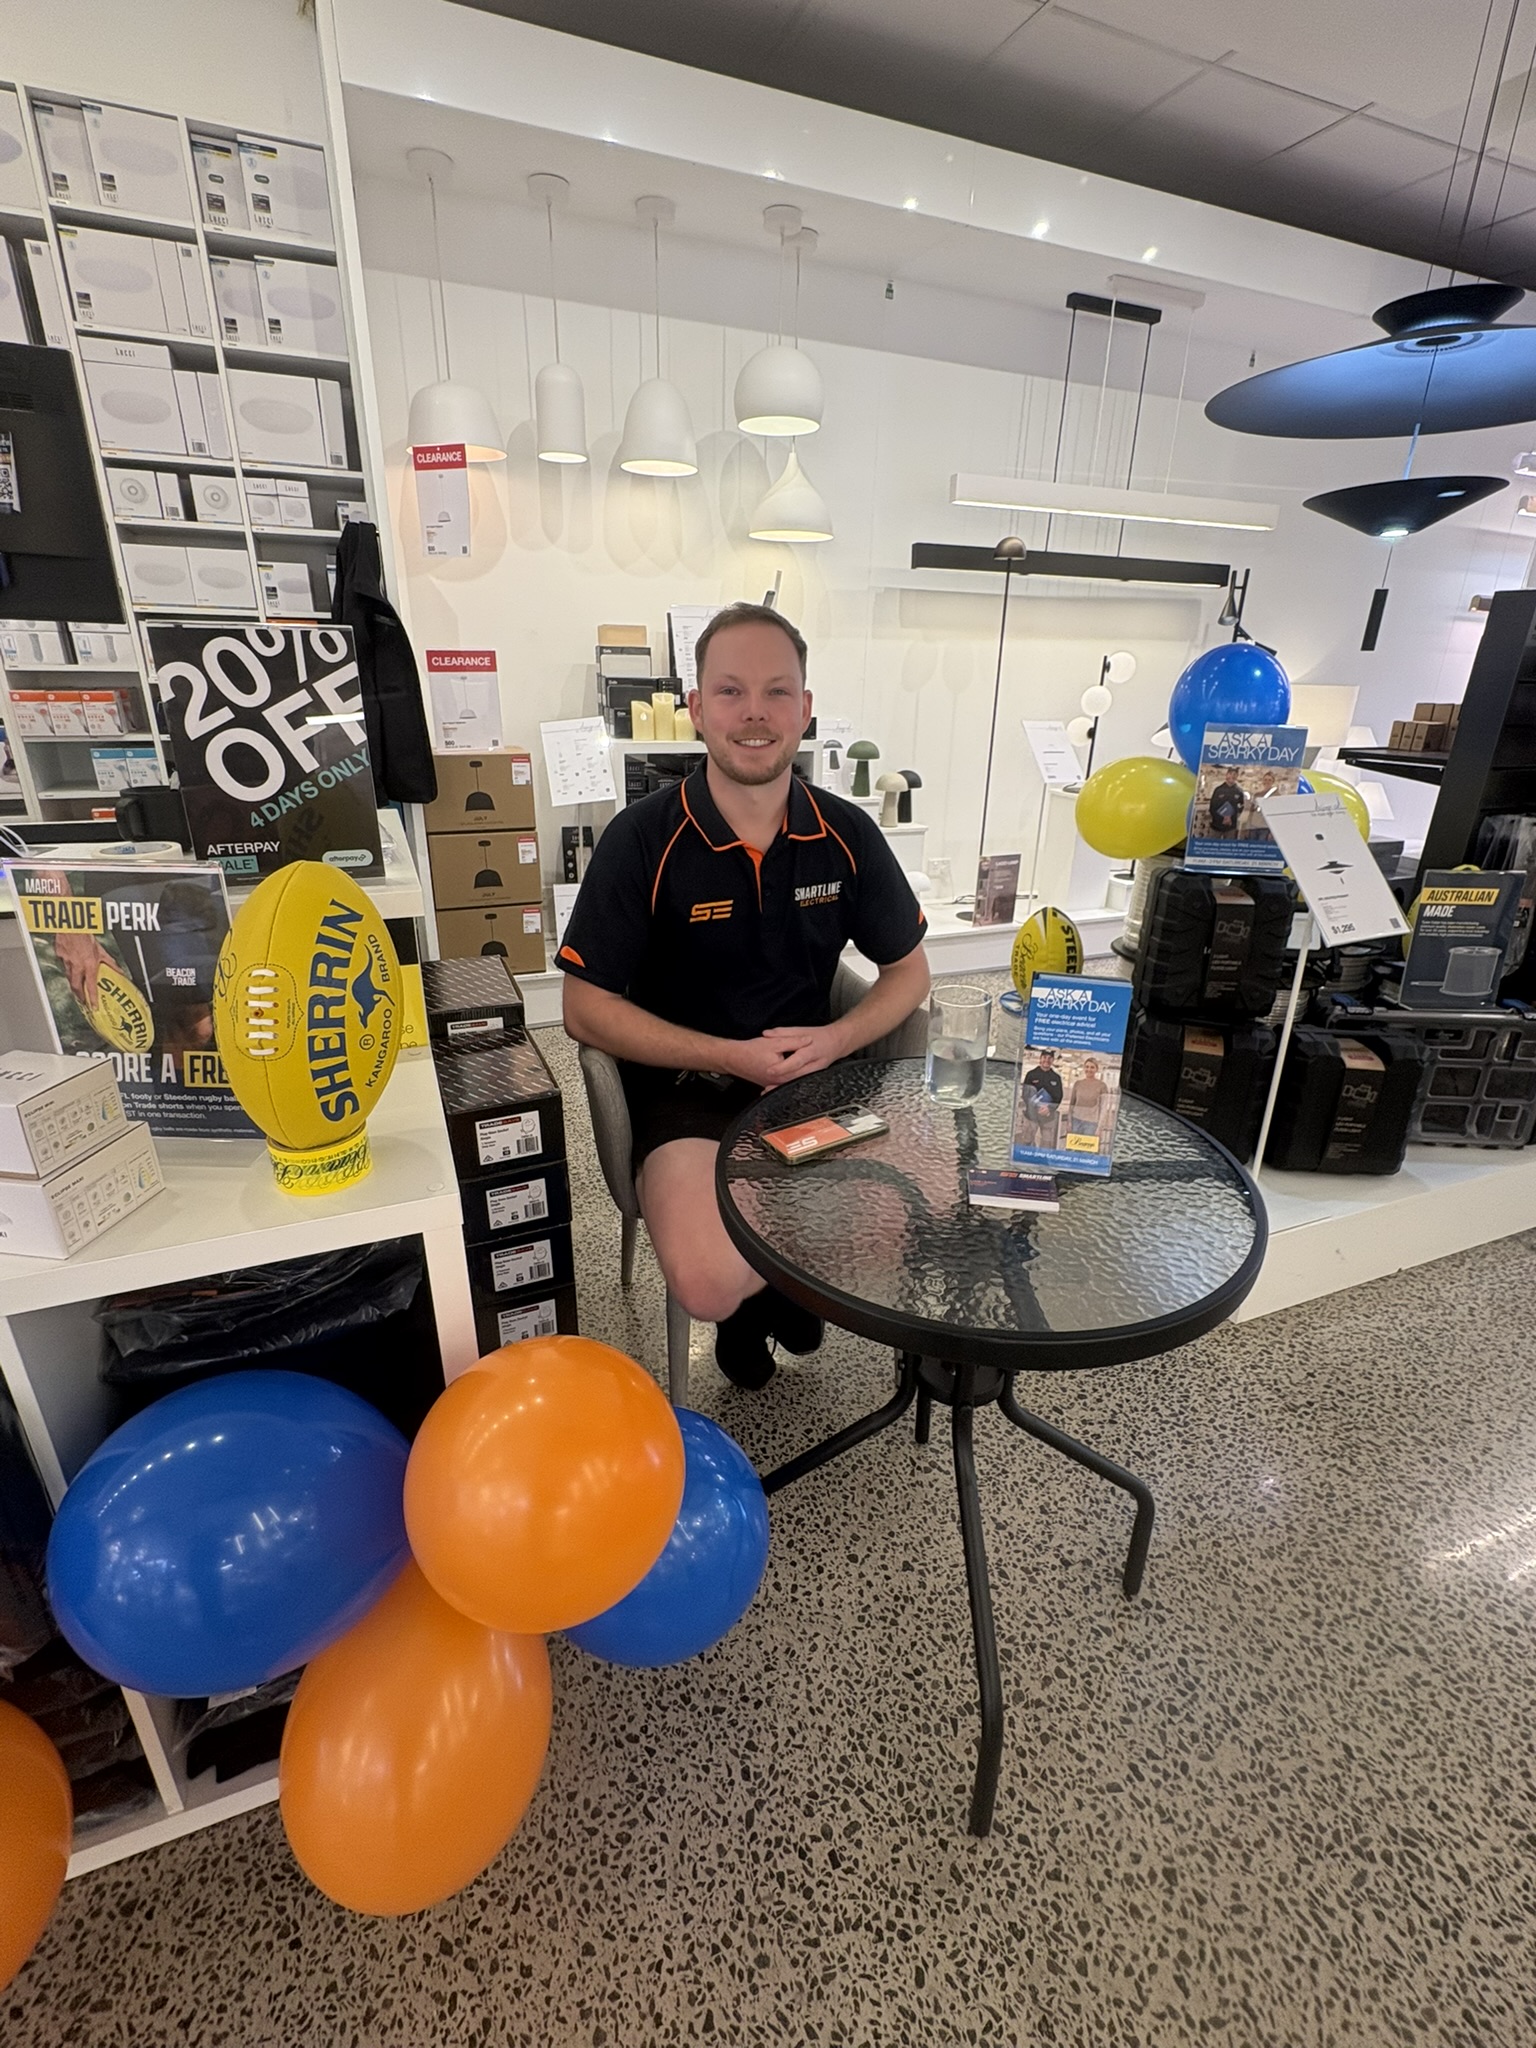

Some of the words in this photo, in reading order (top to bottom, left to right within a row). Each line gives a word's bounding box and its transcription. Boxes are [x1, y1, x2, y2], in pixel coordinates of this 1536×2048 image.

[416, 451, 462, 463] CLEARANCE
[431, 656, 491, 667] CLEARANCE
[157, 628, 348, 741] 20%
[205, 660, 368, 803] OFF
[1219, 732, 1252, 747] ASK
[1257, 734, 1269, 748] A
[1208, 745, 1268, 761] SPARKY
[1267, 747, 1300, 762] DAY
[250, 812, 265, 829] 4
[260, 780, 319, 823] DAYS
[317, 748, 371, 789] ONLY
[206, 841, 281, 856] AFTERPAY
[328, 853, 360, 864] afterpay
[24, 877, 61, 894] MARCH
[794, 881, 843, 901] SMARTLINE
[799, 895, 840, 908] ELECTRICAL
[1426, 889, 1496, 903] AUSTRALIAN
[28, 900, 99, 930] TRADE
[105, 901, 162, 932] PERK
[1423, 905, 1456, 918] MADE
[1060, 925, 1078, 974] STEED
[367, 933, 392, 983] BRAND
[165, 967, 196, 979] BEACON
[1045, 988, 1075, 1000] ASK
[1079, 990, 1089, 1001] A
[96, 976, 149, 1049] SHERRIN
[306, 897, 365, 1124] SHERRIN
[1036, 998, 1088, 1011] SPARKY
[1088, 1000, 1116, 1014] DAY
[365, 1007, 394, 1089] KANGAROO
[161, 1053, 177, 1083] A
[189, 1055, 229, 1084] FRE
[131, 1093, 152, 1101] footy
[163, 1093, 197, 1101] Steeden
[198, 1095, 222, 1103] rugby
[162, 1111, 207, 1119] transaction.
